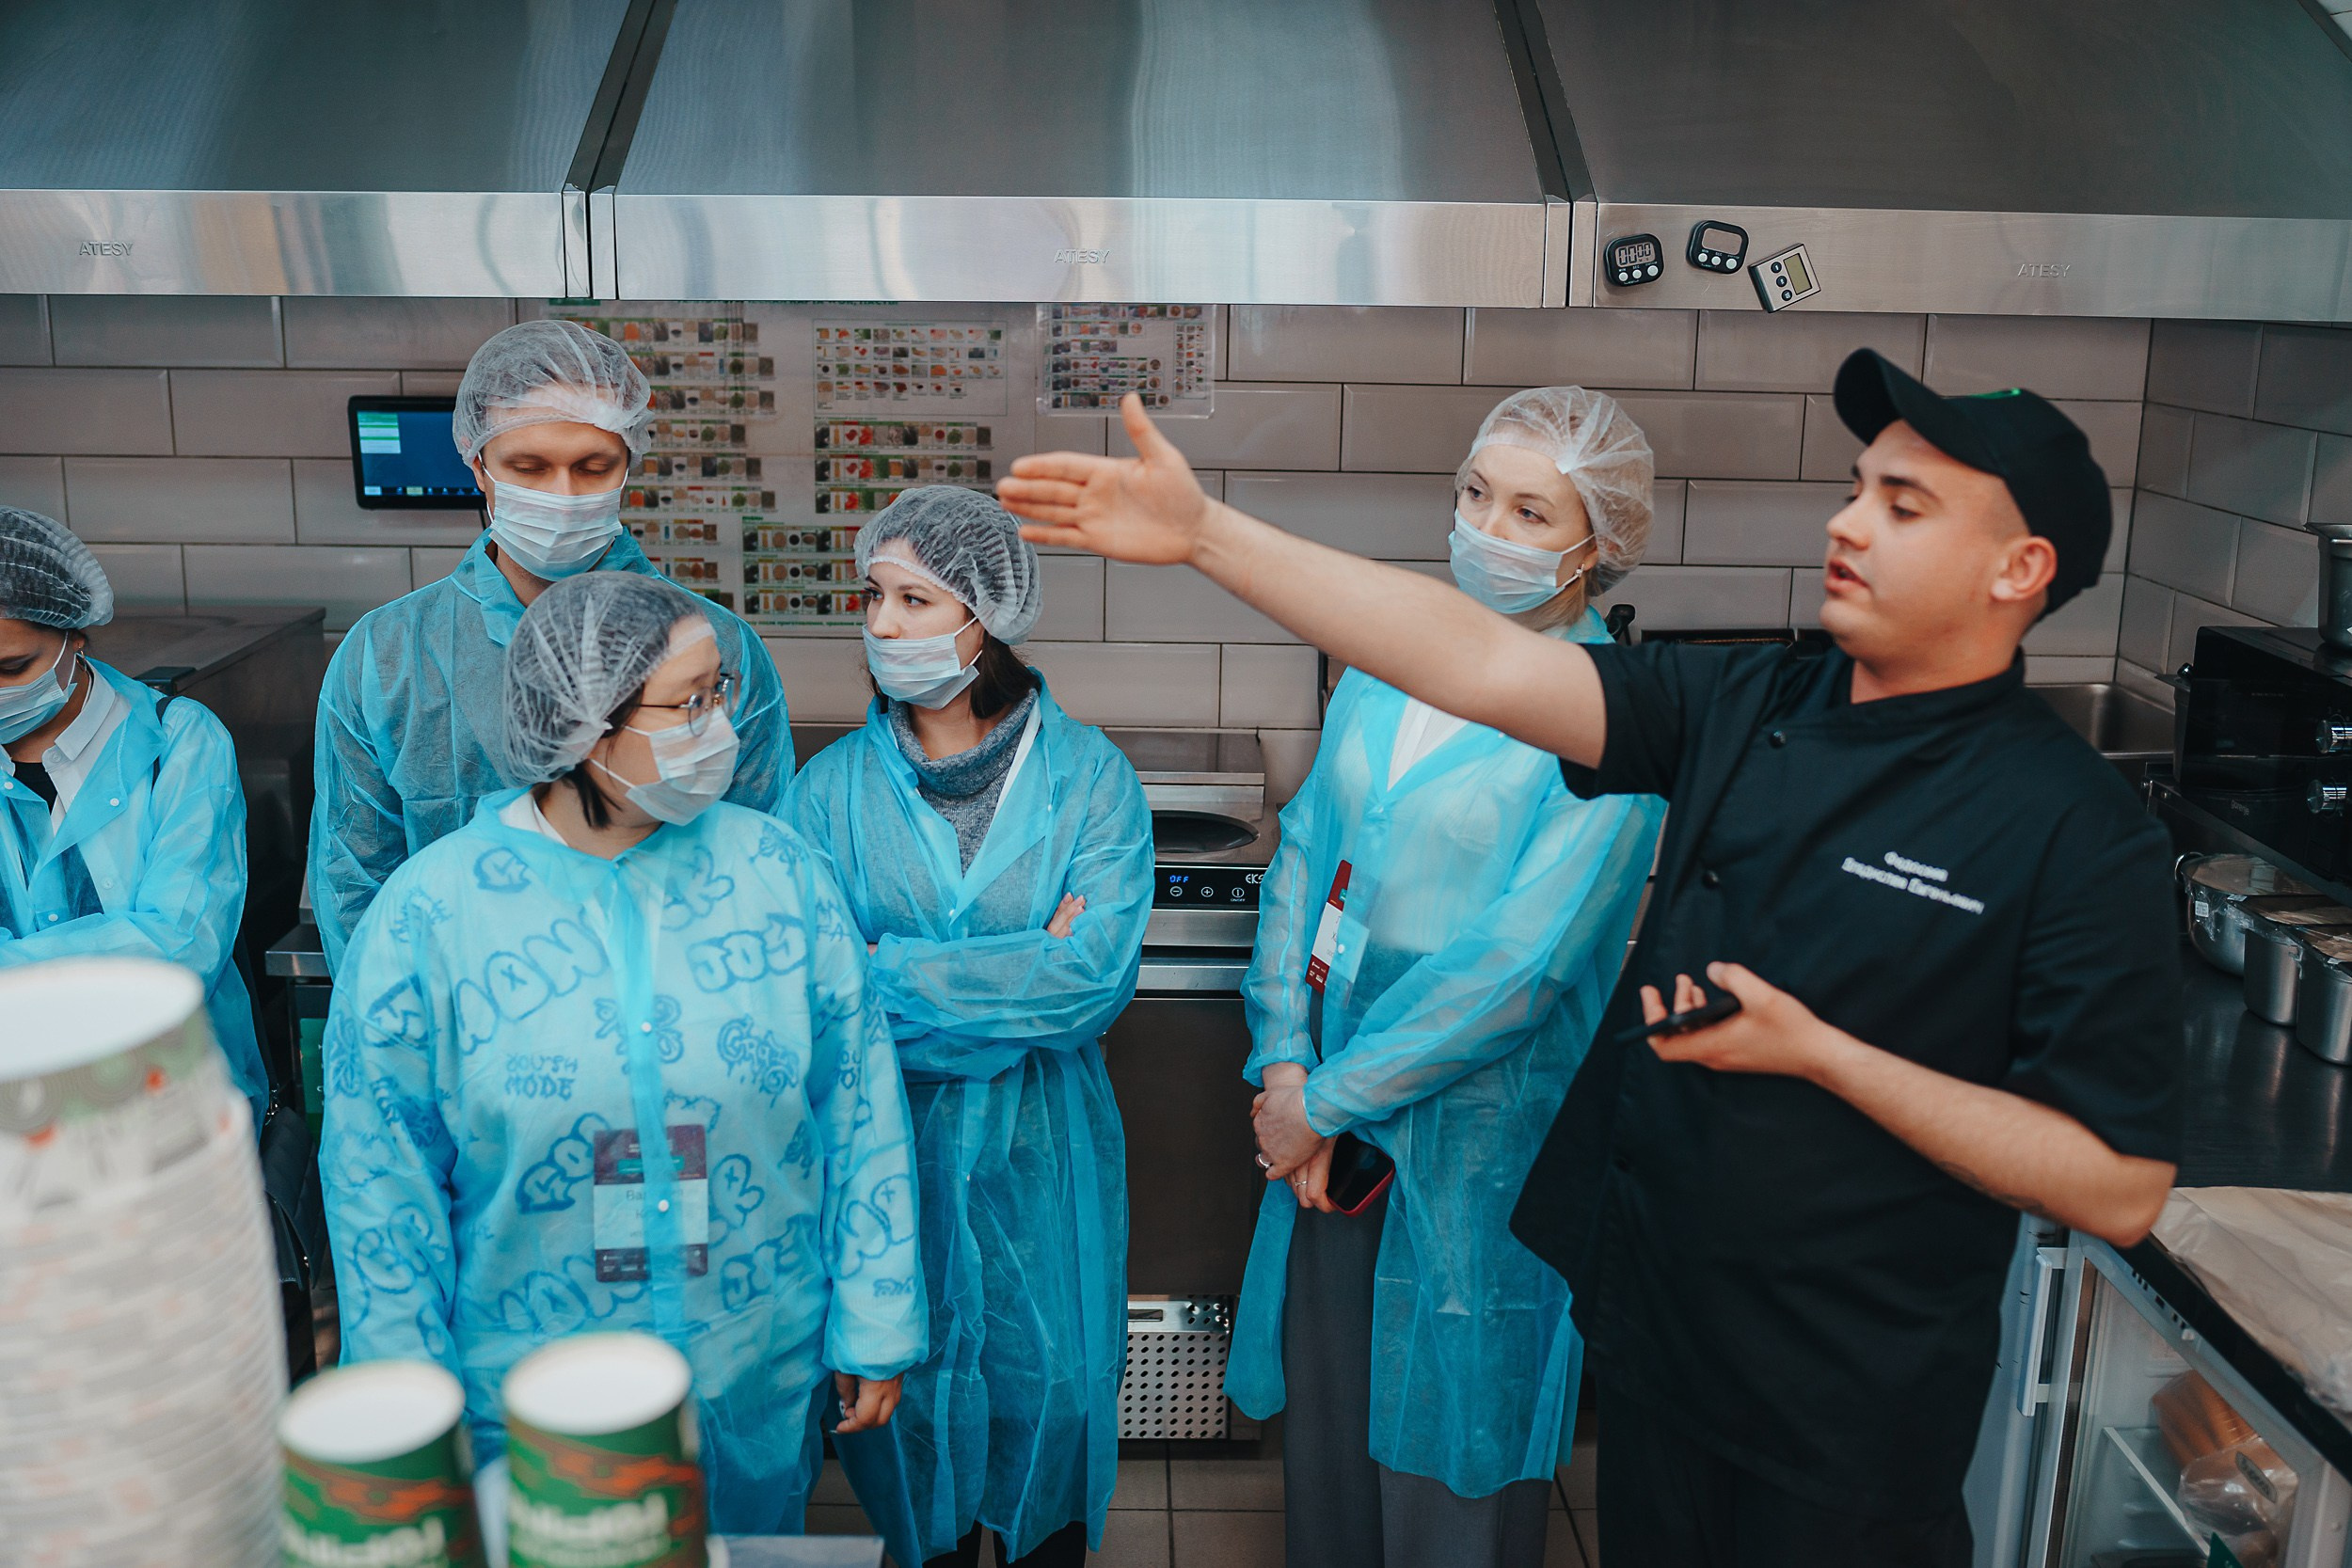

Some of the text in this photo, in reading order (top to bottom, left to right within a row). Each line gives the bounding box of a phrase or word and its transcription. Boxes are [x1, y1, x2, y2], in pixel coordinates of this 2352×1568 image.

[79, 242, 133, 256] ATESY
[1054, 248, 1110, 264] ATESY
[2017, 263, 2071, 278] ATESY
